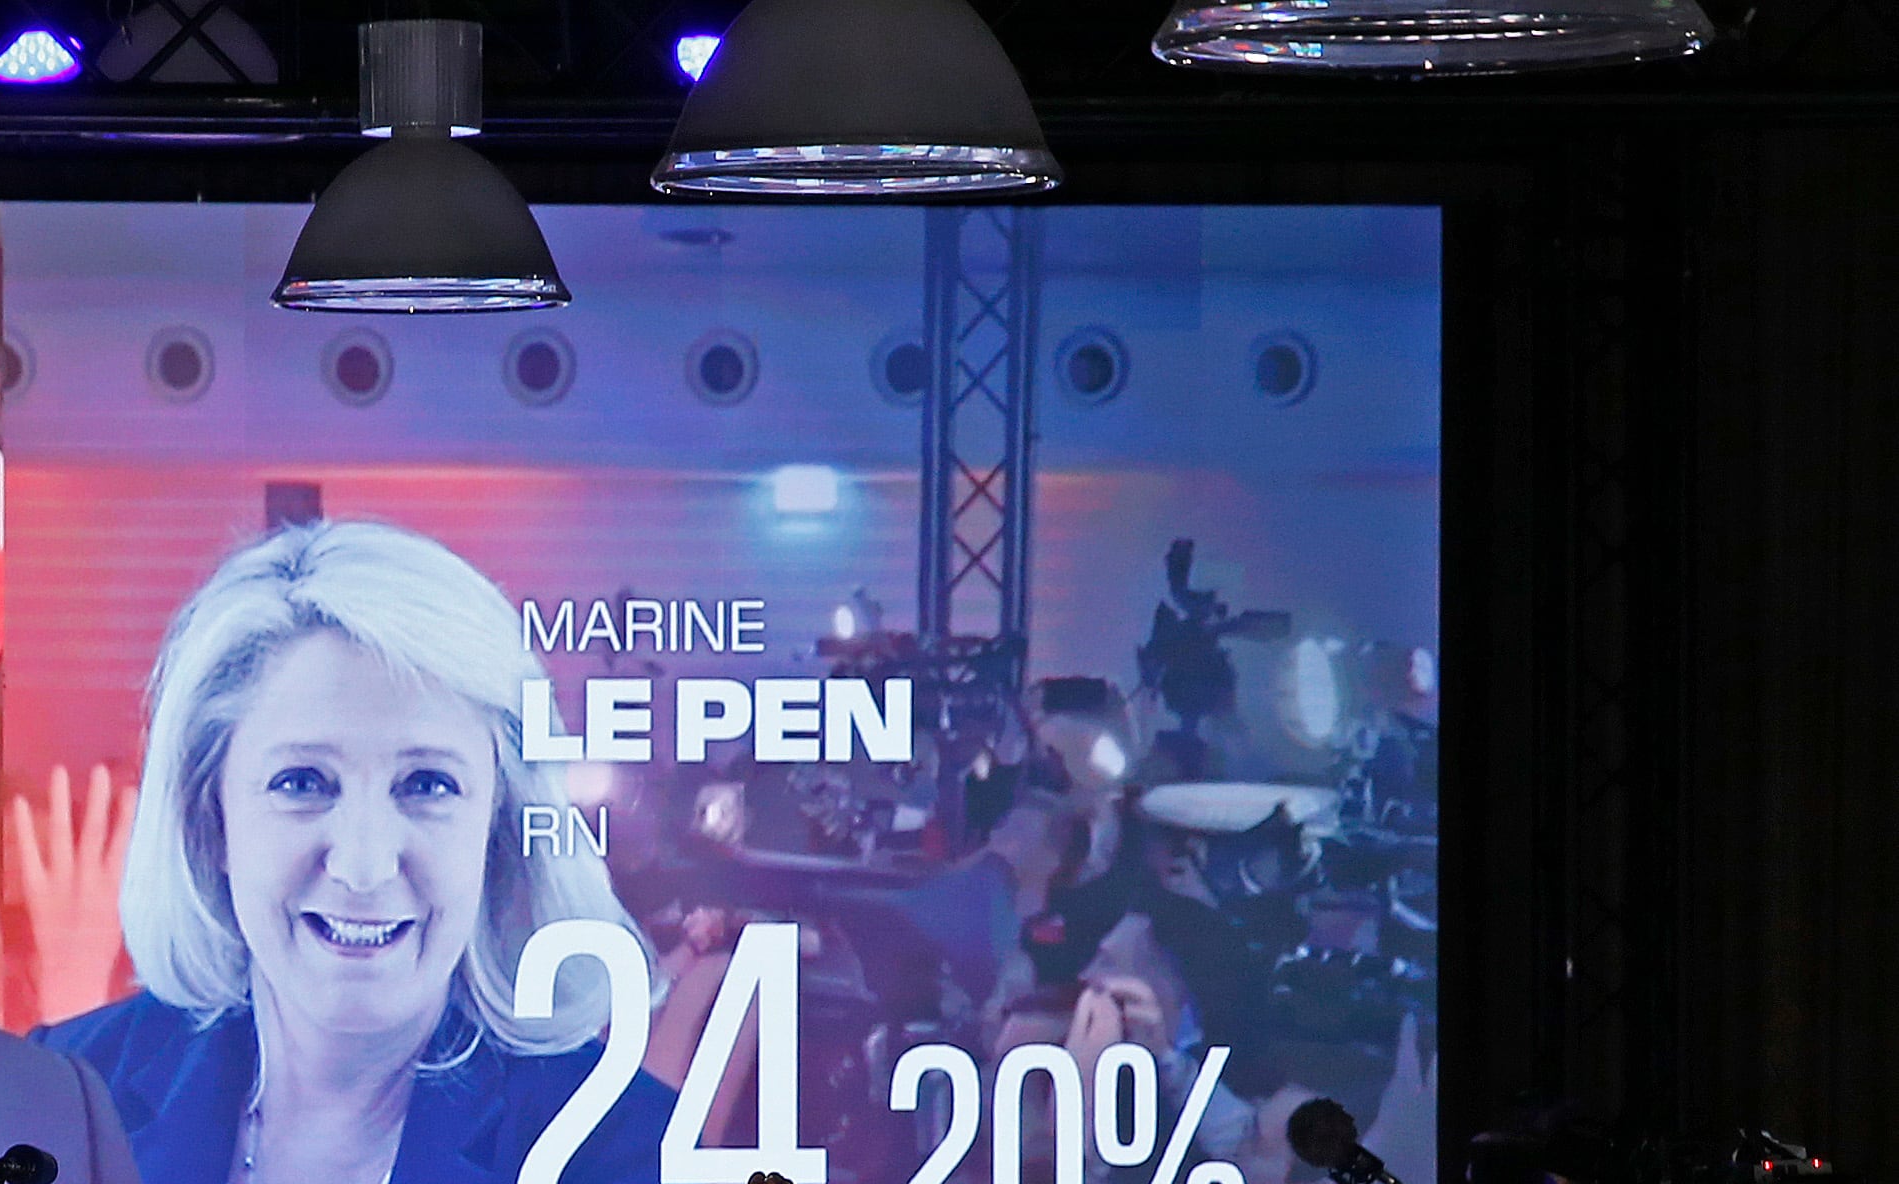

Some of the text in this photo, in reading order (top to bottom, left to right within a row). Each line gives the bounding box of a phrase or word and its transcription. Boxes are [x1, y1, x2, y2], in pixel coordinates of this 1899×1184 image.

[522, 600, 765, 653] MARINE
[521, 678, 913, 762] LE PEN
[522, 805, 608, 858] RN
